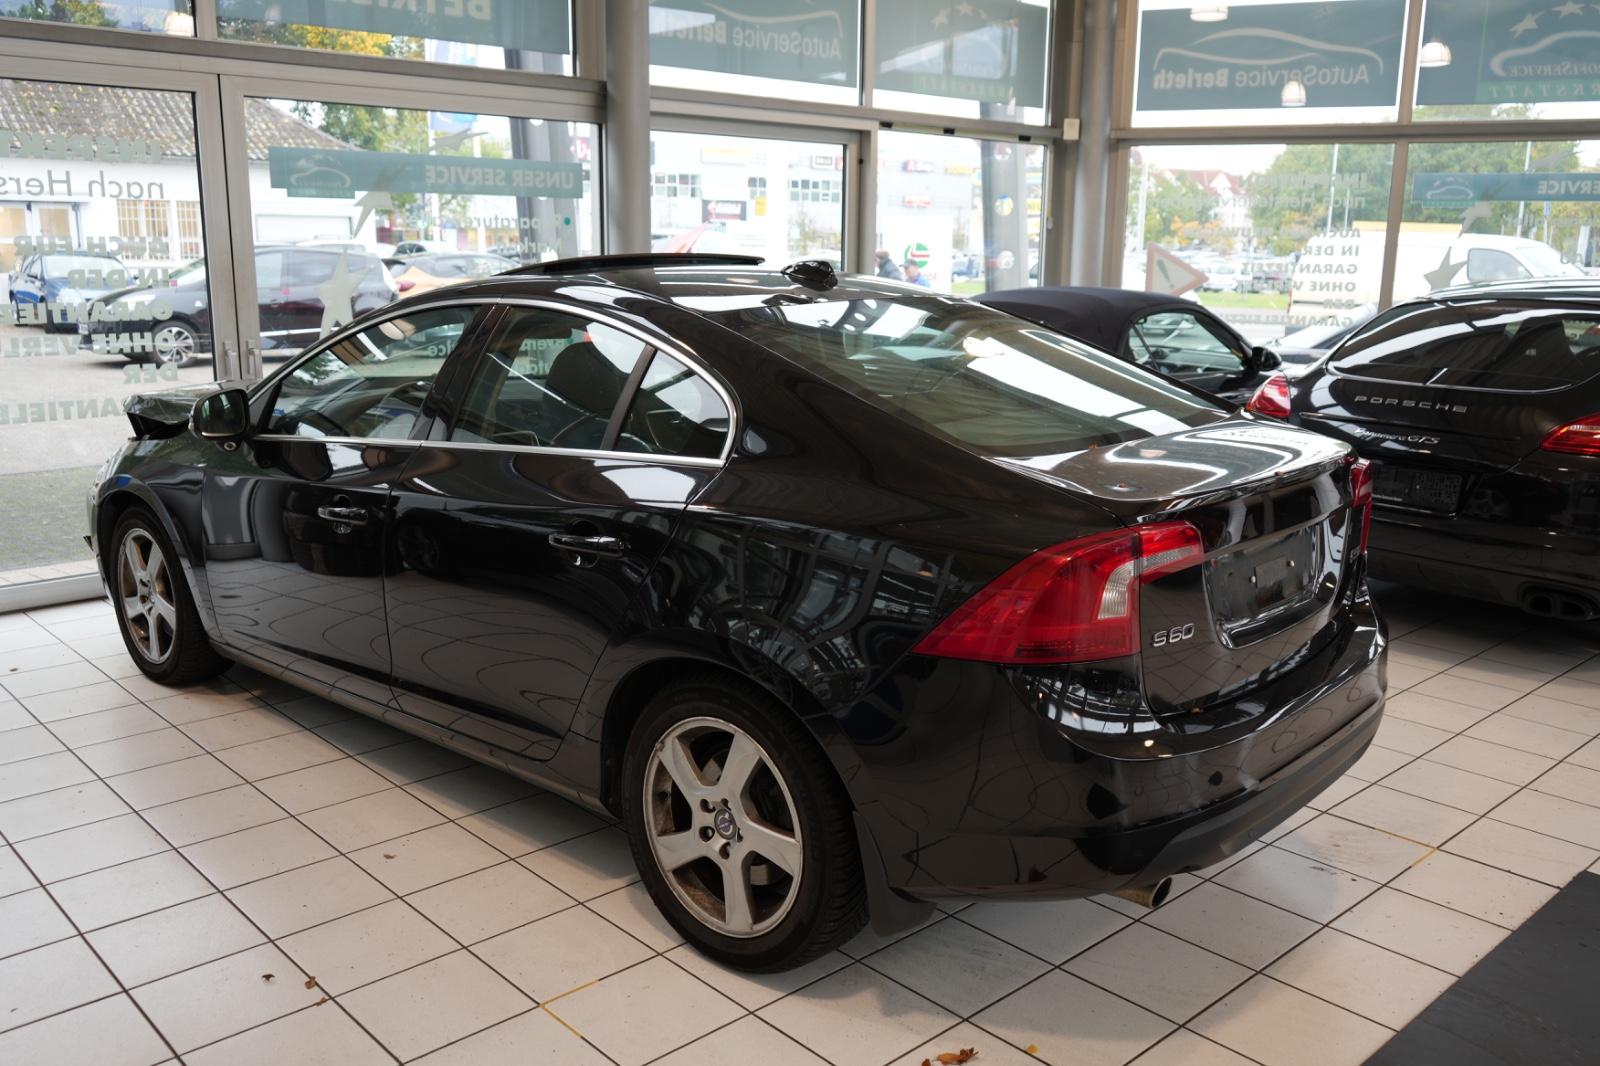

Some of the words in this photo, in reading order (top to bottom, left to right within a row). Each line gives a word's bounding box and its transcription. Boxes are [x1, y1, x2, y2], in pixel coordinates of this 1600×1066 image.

[1354, 395, 1468, 413] PORSCHE
[1408, 435, 1441, 445] GTS
[1152, 622, 1195, 648] S60
